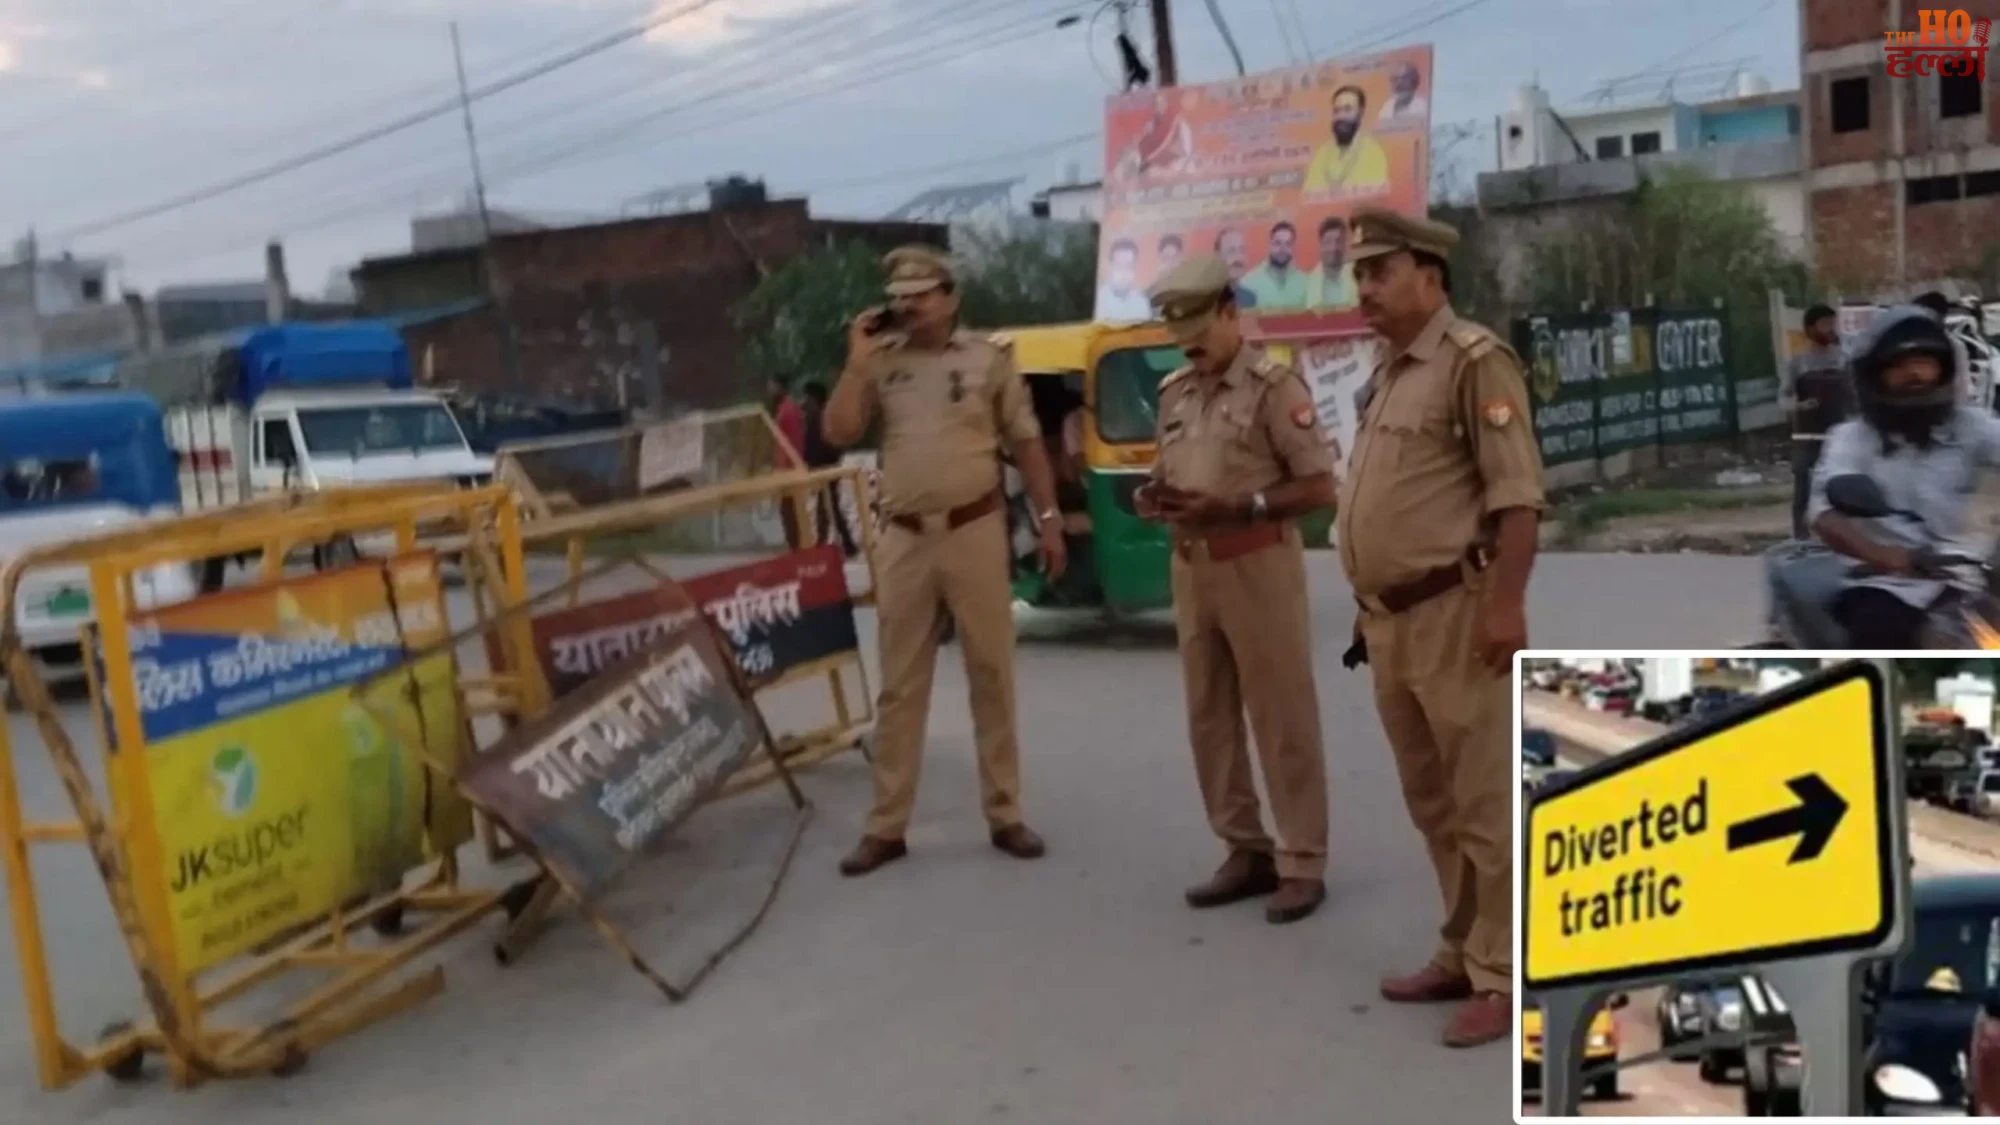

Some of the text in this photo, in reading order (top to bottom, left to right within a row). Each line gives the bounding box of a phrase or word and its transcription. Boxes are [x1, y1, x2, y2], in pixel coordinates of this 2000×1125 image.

[1657, 319, 1724, 372] CENTER
[1544, 777, 1708, 877] Diverted
[1560, 867, 1683, 937] traffic
